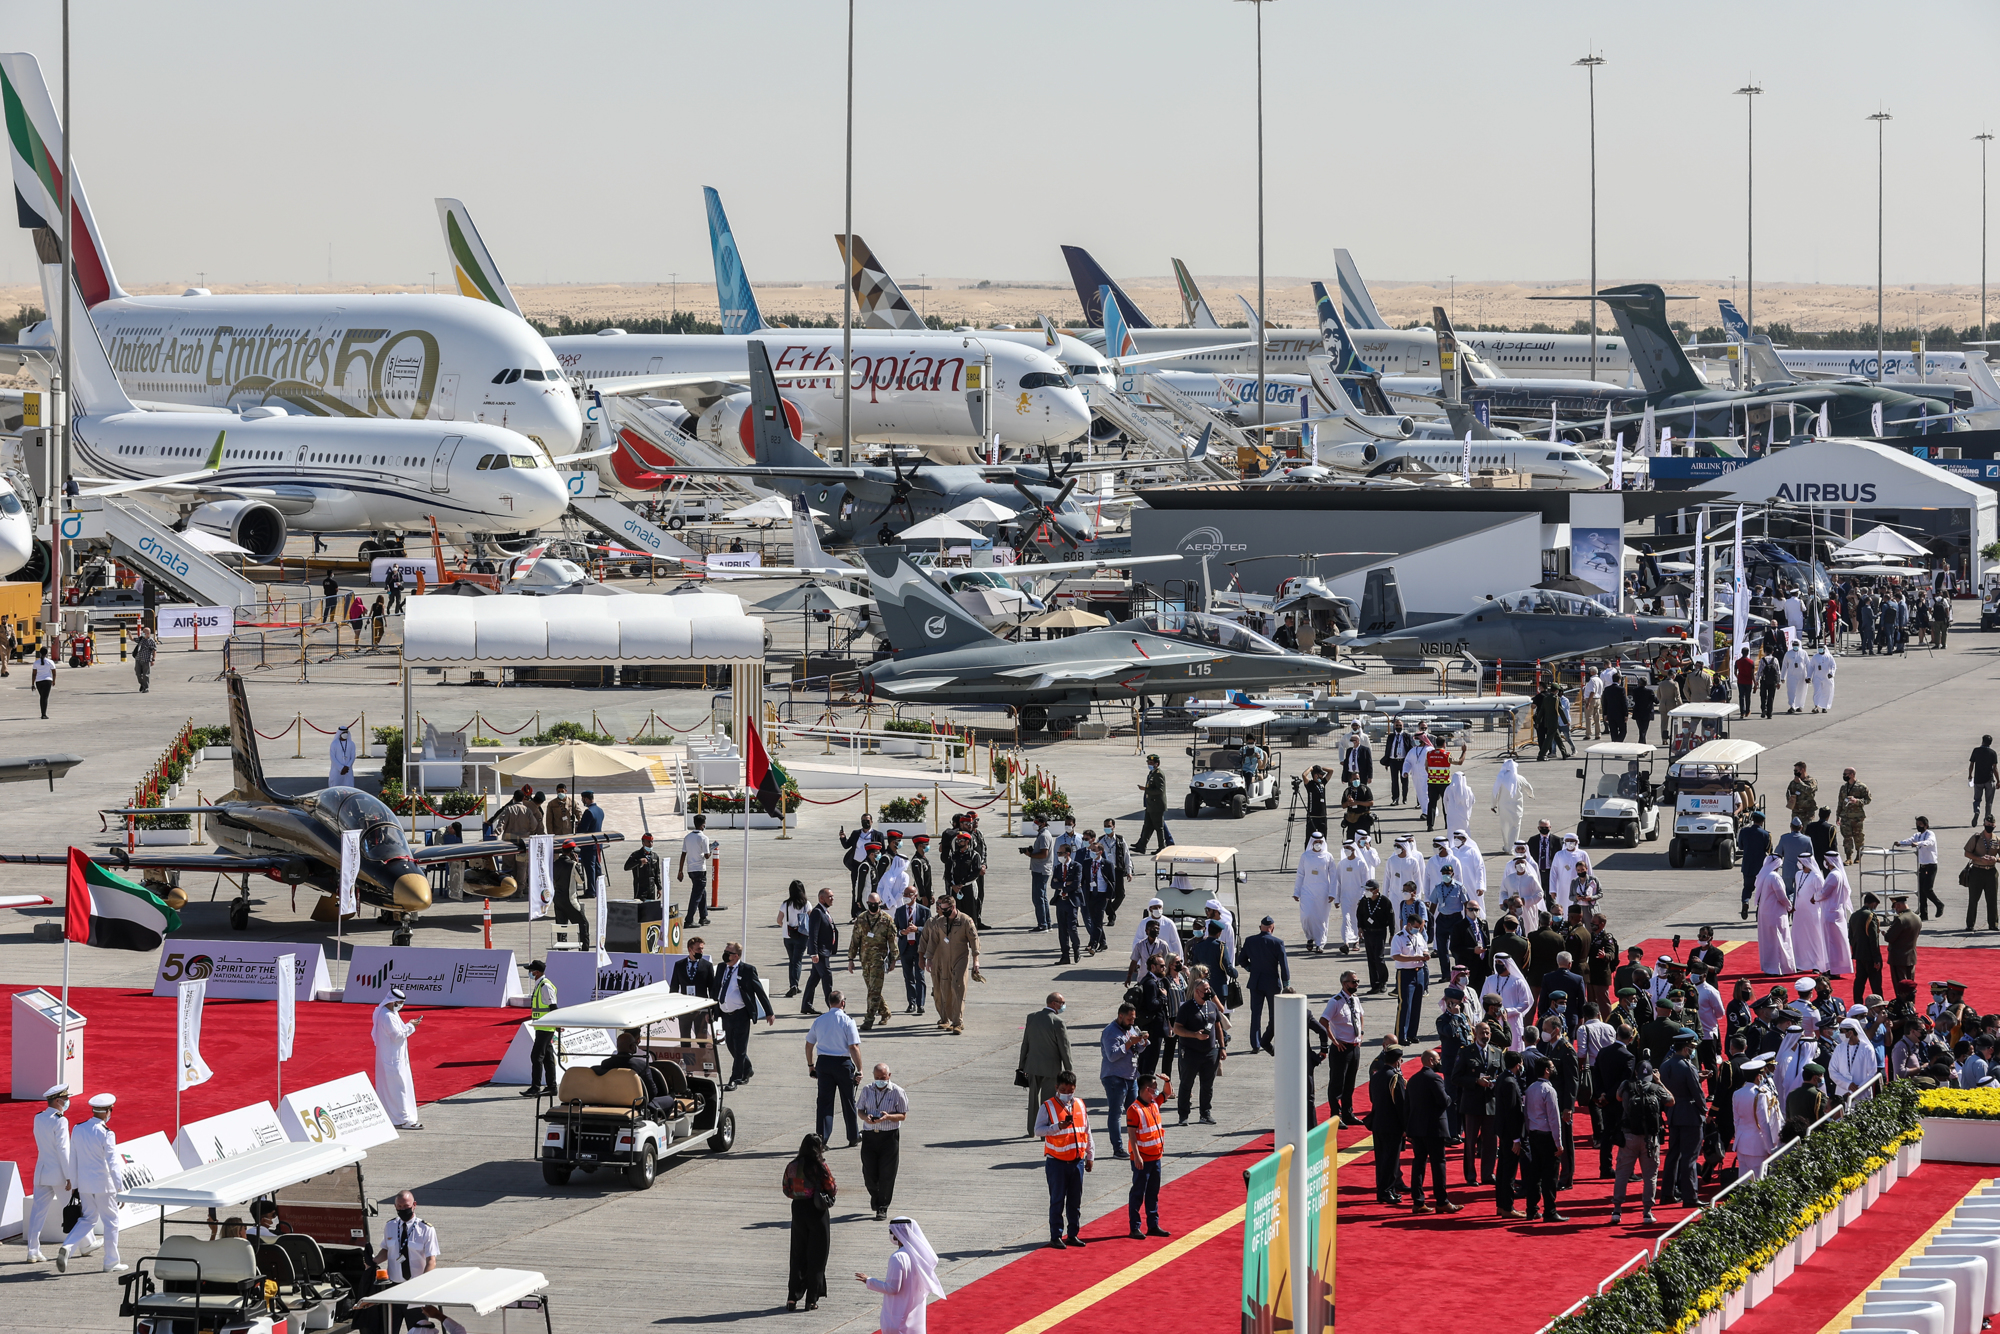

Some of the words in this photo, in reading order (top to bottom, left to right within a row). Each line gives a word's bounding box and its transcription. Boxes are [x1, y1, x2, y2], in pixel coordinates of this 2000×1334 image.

[724, 309, 747, 328] 777
[108, 335, 165, 373] United
[161, 337, 205, 375] Arab
[206, 323, 335, 387] Emirates
[1264, 340, 1325, 352] ETIHA
[333, 328, 440, 419] 50
[774, 345, 965, 404] Ethopian
[1848, 358, 1935, 376] MC-21-30
[966, 372, 980, 382] S804
[23, 403, 39, 416] S803
[663, 429, 687, 448] dnata
[770, 435, 782, 444] 823
[1691, 462, 1721, 470] AIRLINK
[1775, 483, 1877, 503] AIRBUS
[624, 519, 661, 549] dnata
[1063, 551, 1085, 562] 608
[1184, 543, 1248, 552] AEROTER
[138, 537, 190, 577] dnata
[385, 566, 426, 575] ARBUS
[173, 616, 219, 628] AIRBUS
[1367, 621, 1396, 631] AT-6
[1419, 642, 1470, 655] N610AT
[1188, 663, 1212, 676] L15
[215, 965, 243, 973] SPIRIT
[245, 965, 257, 974] OF
[259, 966, 276, 974] THE
[389, 983, 404, 991] THE
[405, 983, 443, 992] EMIRATES
[331, 1110, 348, 1123] SPIRIT
[346, 1108, 354, 1118] OF
[353, 1105, 364, 1116] THE
[362, 1101, 379, 1113] UNION
[1307, 1155, 1330, 1180] NGINEERING
[1312, 1172, 1329, 1194] FUTURE
[1253, 1185, 1281, 1215] ENGINEERING
[1312, 1188, 1329, 1215] FLIGHT
[1253, 1213, 1261, 1233] THE
[1260, 1202, 1280, 1229] FUTURE
[1251, 1232, 1261, 1253] OF
[1260, 1220, 1280, 1248] FLIGHT
